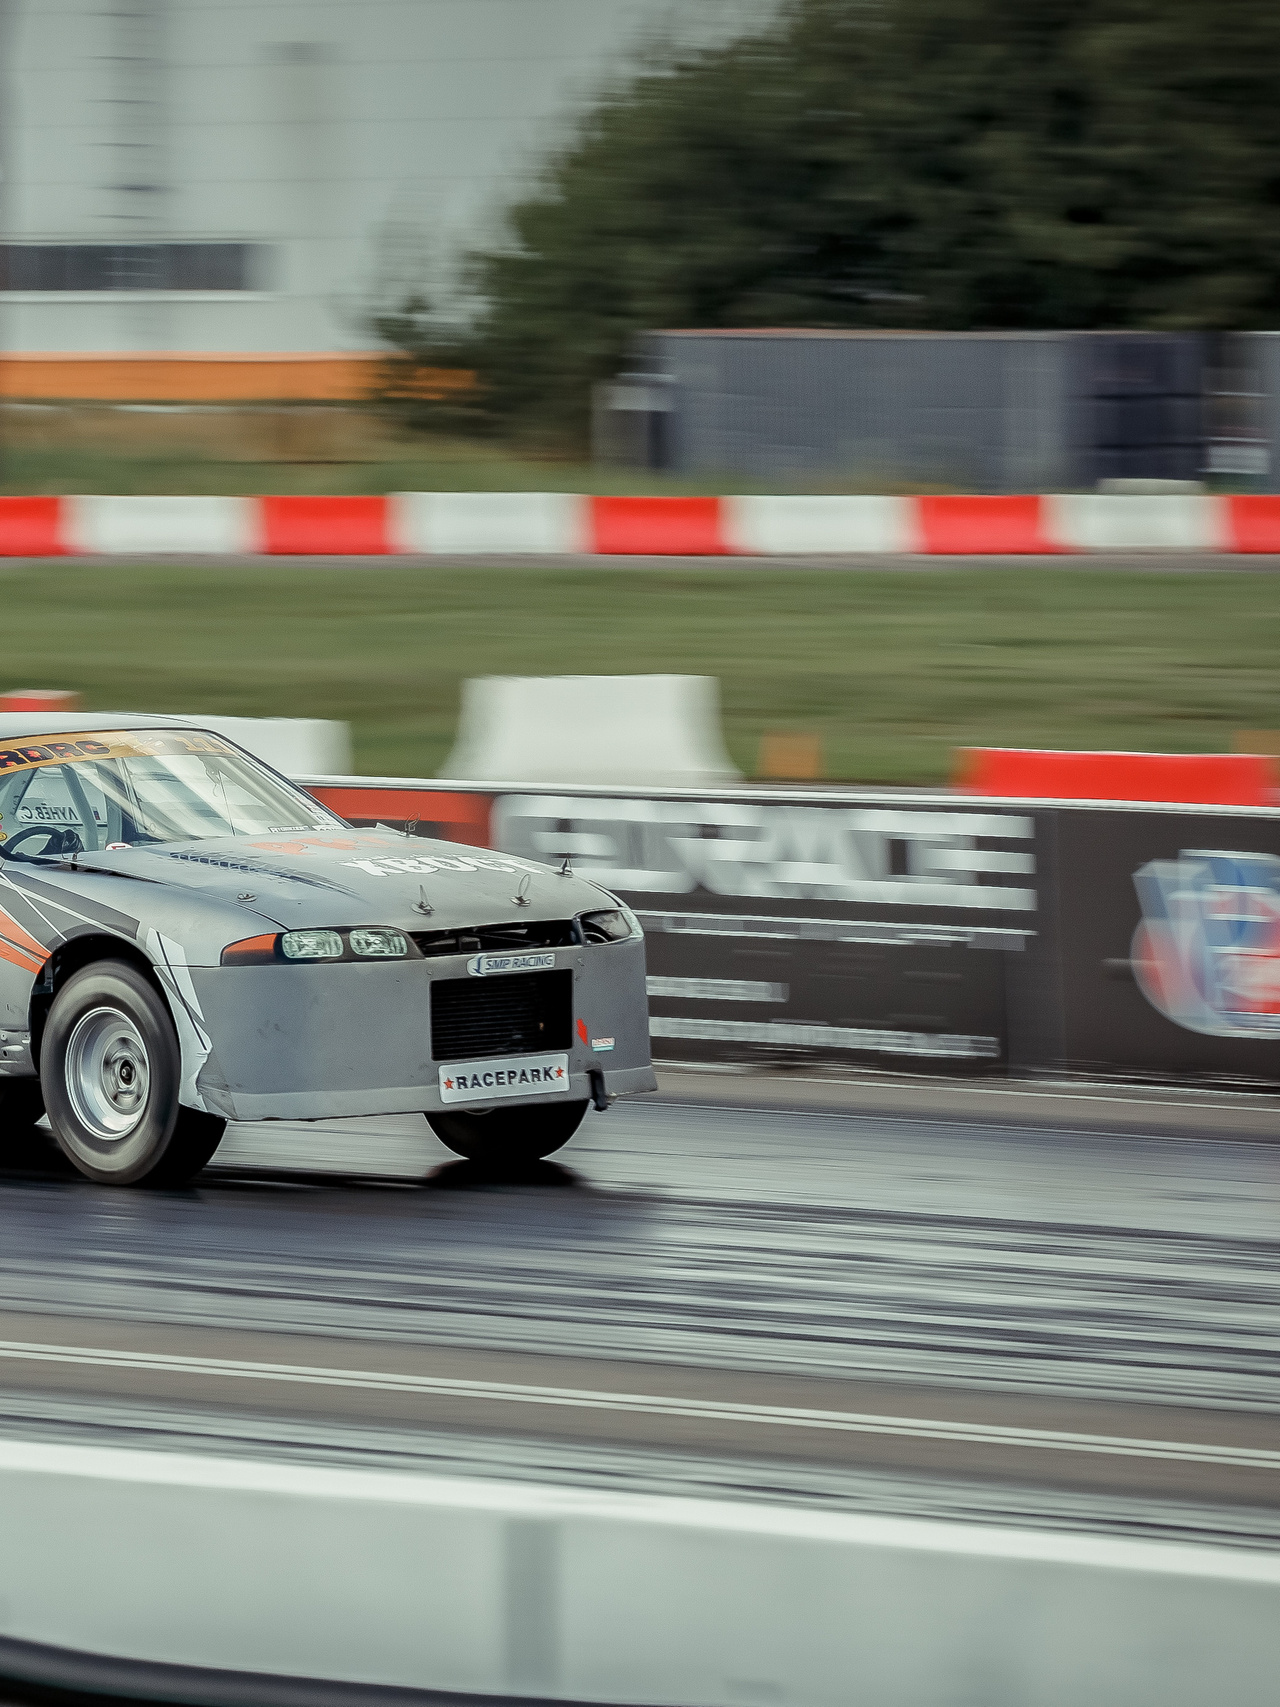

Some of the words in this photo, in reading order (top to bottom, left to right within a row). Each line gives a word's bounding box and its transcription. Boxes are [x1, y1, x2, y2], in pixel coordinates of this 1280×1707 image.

[485, 959, 511, 971] SMP
[512, 954, 553, 969] RACING
[455, 1066, 555, 1090] RACEPARK
